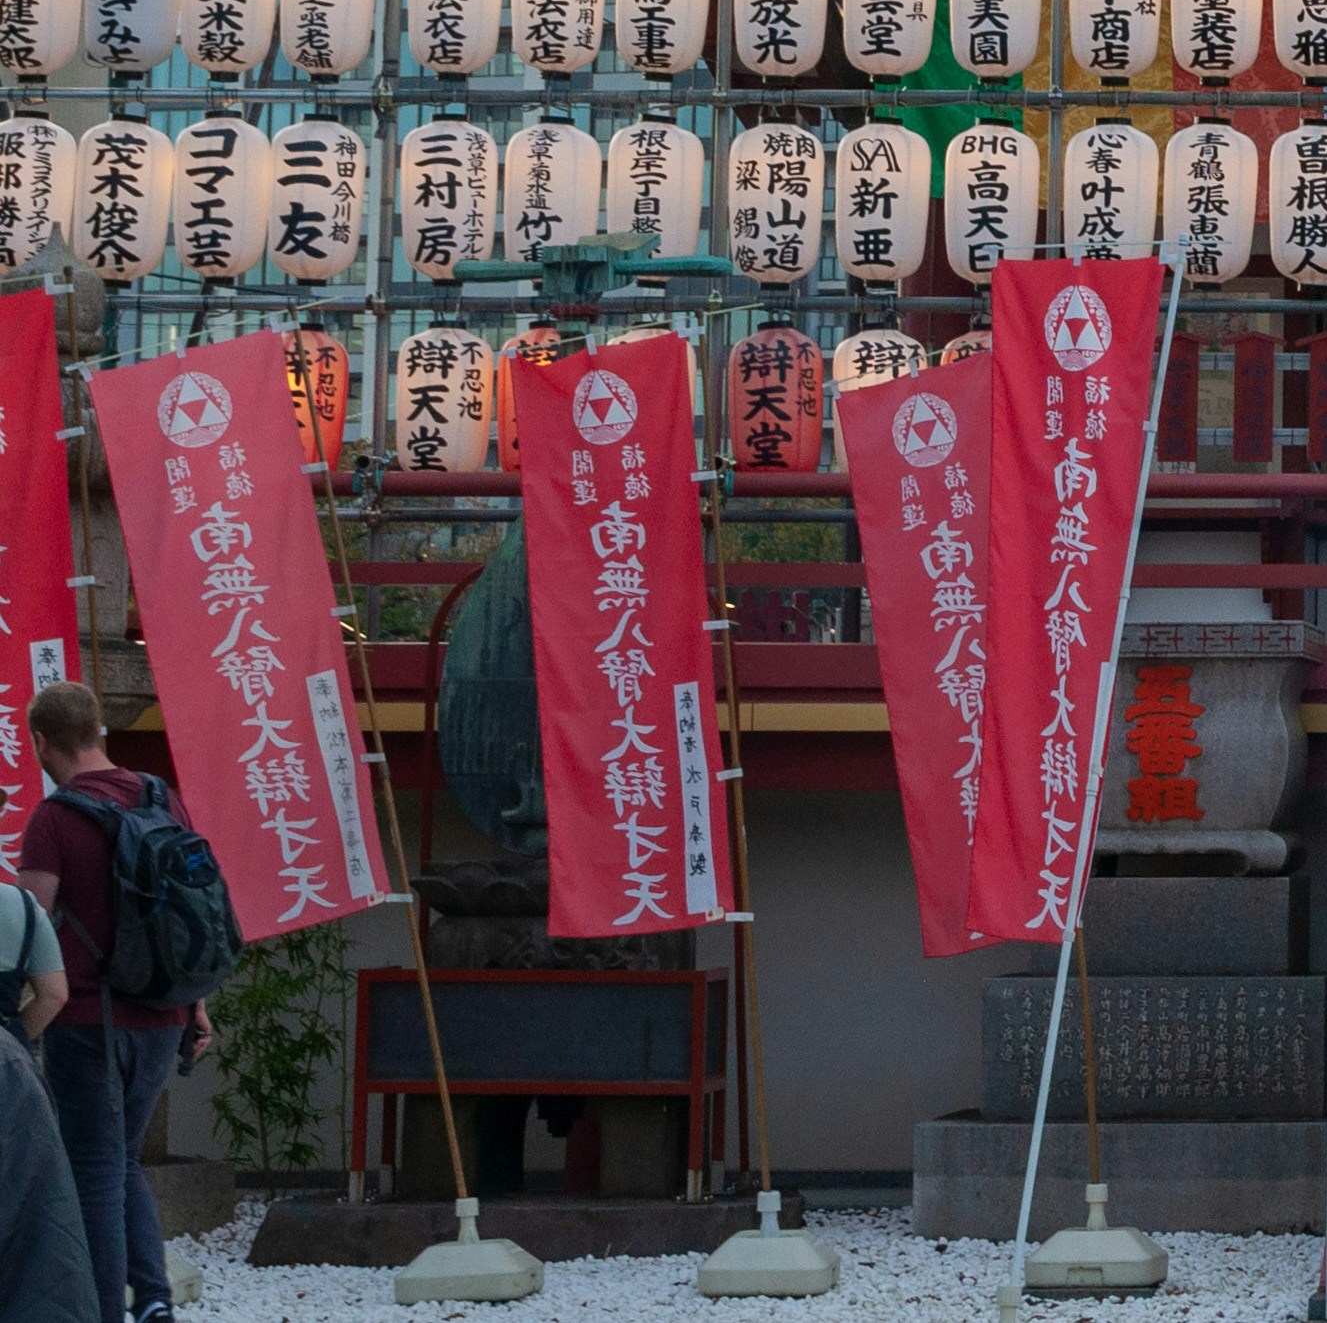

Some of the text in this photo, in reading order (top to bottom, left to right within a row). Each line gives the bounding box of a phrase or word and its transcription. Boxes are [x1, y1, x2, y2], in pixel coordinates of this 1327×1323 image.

[274, 140, 332, 259] 三友
[329, 135, 357, 244] 神田今川橋
[459, 132, 487, 260] 浅草ビューホテル
[763, 133, 816, 159] 焼肉
[960, 135, 1018, 156] BHG
[85, 133, 148, 272] 茂木俊介
[762, 160, 811, 272] 陽山道
[848, 178, 898, 267] 新亜
[459, 342, 483, 421] 不忍池
[795, 342, 817, 416] 不忍池
[1123, 666, 1204, 823] 五番組
